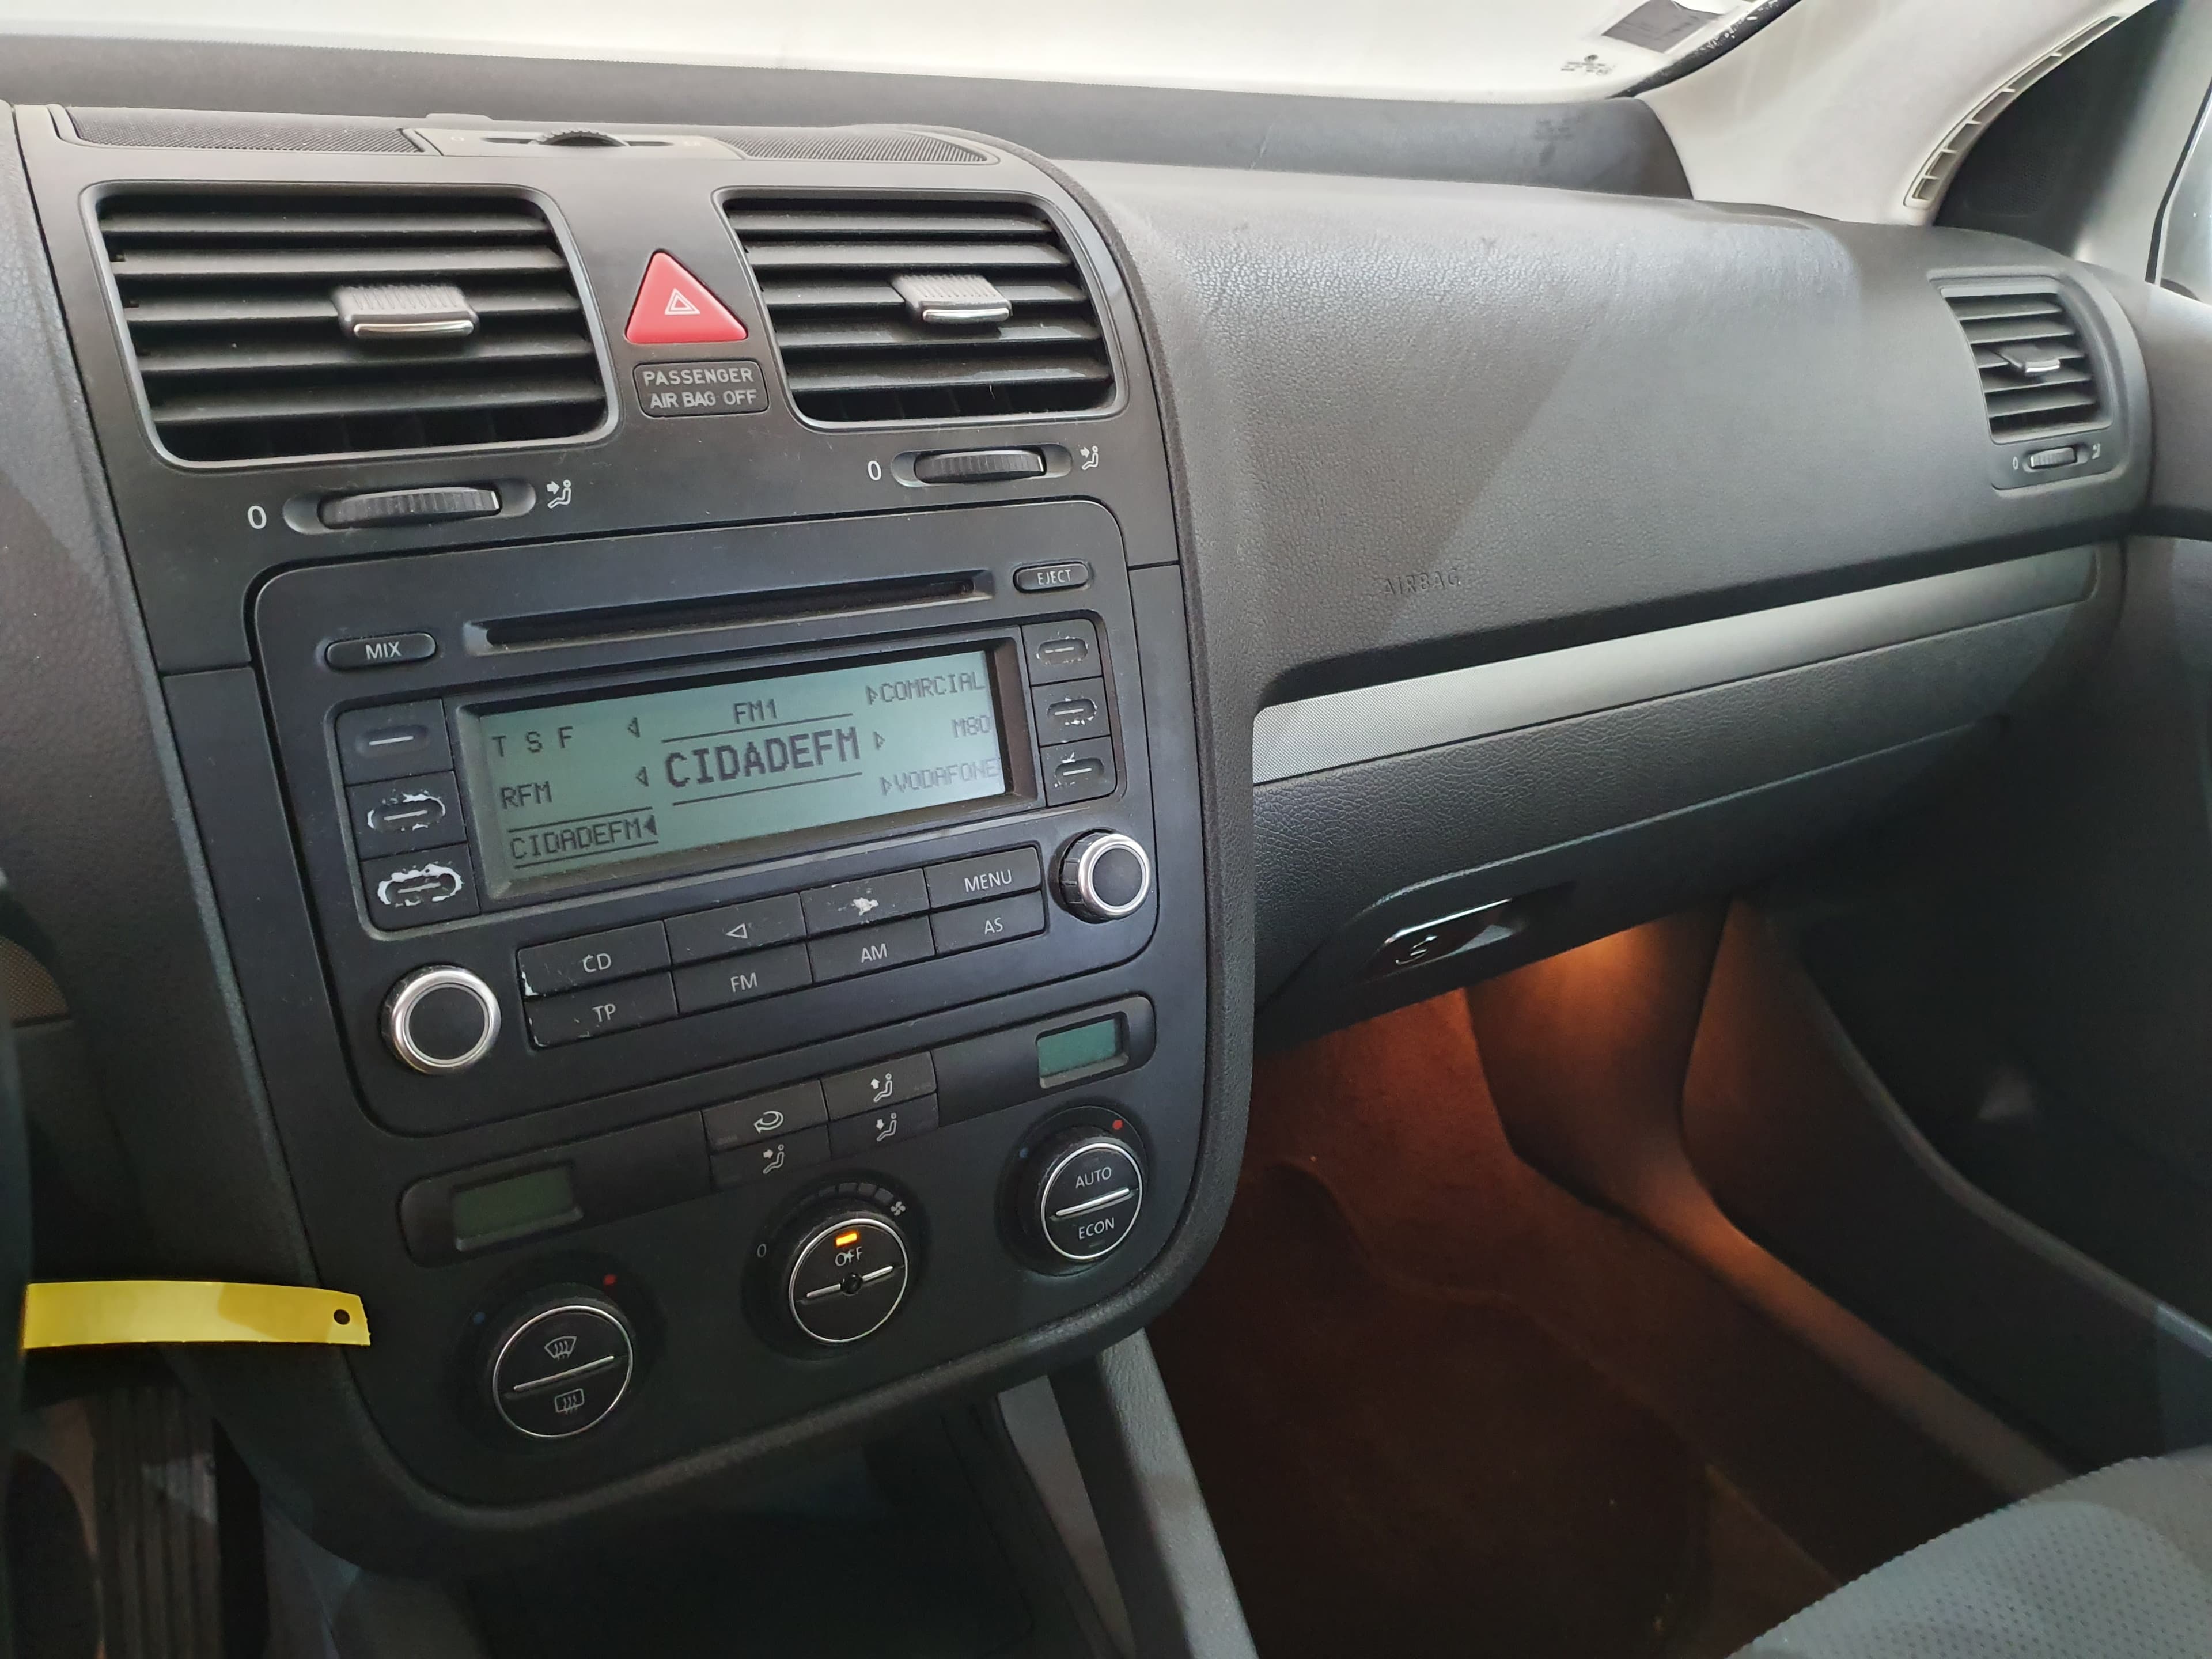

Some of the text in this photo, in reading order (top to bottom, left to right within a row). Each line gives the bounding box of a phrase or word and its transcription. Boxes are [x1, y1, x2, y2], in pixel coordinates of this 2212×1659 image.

[643, 367, 754, 387] PASSENGER
[650, 389, 757, 409] AIR BAG OFF
[1036, 569, 1072, 586] EJECT
[1383, 567, 1460, 595] AIRBAG
[365, 639, 402, 660] MIX
[880, 671, 986, 703] COMRCIAL
[733, 698, 778, 724] FM1
[665, 726, 861, 787] CIDADEFM
[895, 757, 1001, 793] VODAFONE
[500, 780, 552, 809] RFM
[510, 817, 642, 859] CIDADEFM
[964, 869, 1013, 893] MENU
[983, 916, 1003, 935] AS
[582, 952, 612, 973] CD
[861, 942, 888, 963] AM
[730, 972, 759, 993] FM
[592, 1003, 616, 1023] TP
[1075, 1166, 1112, 1189] AUTO
[1078, 1217, 1115, 1240] ECON
[834, 1246, 863, 1267] OFF
